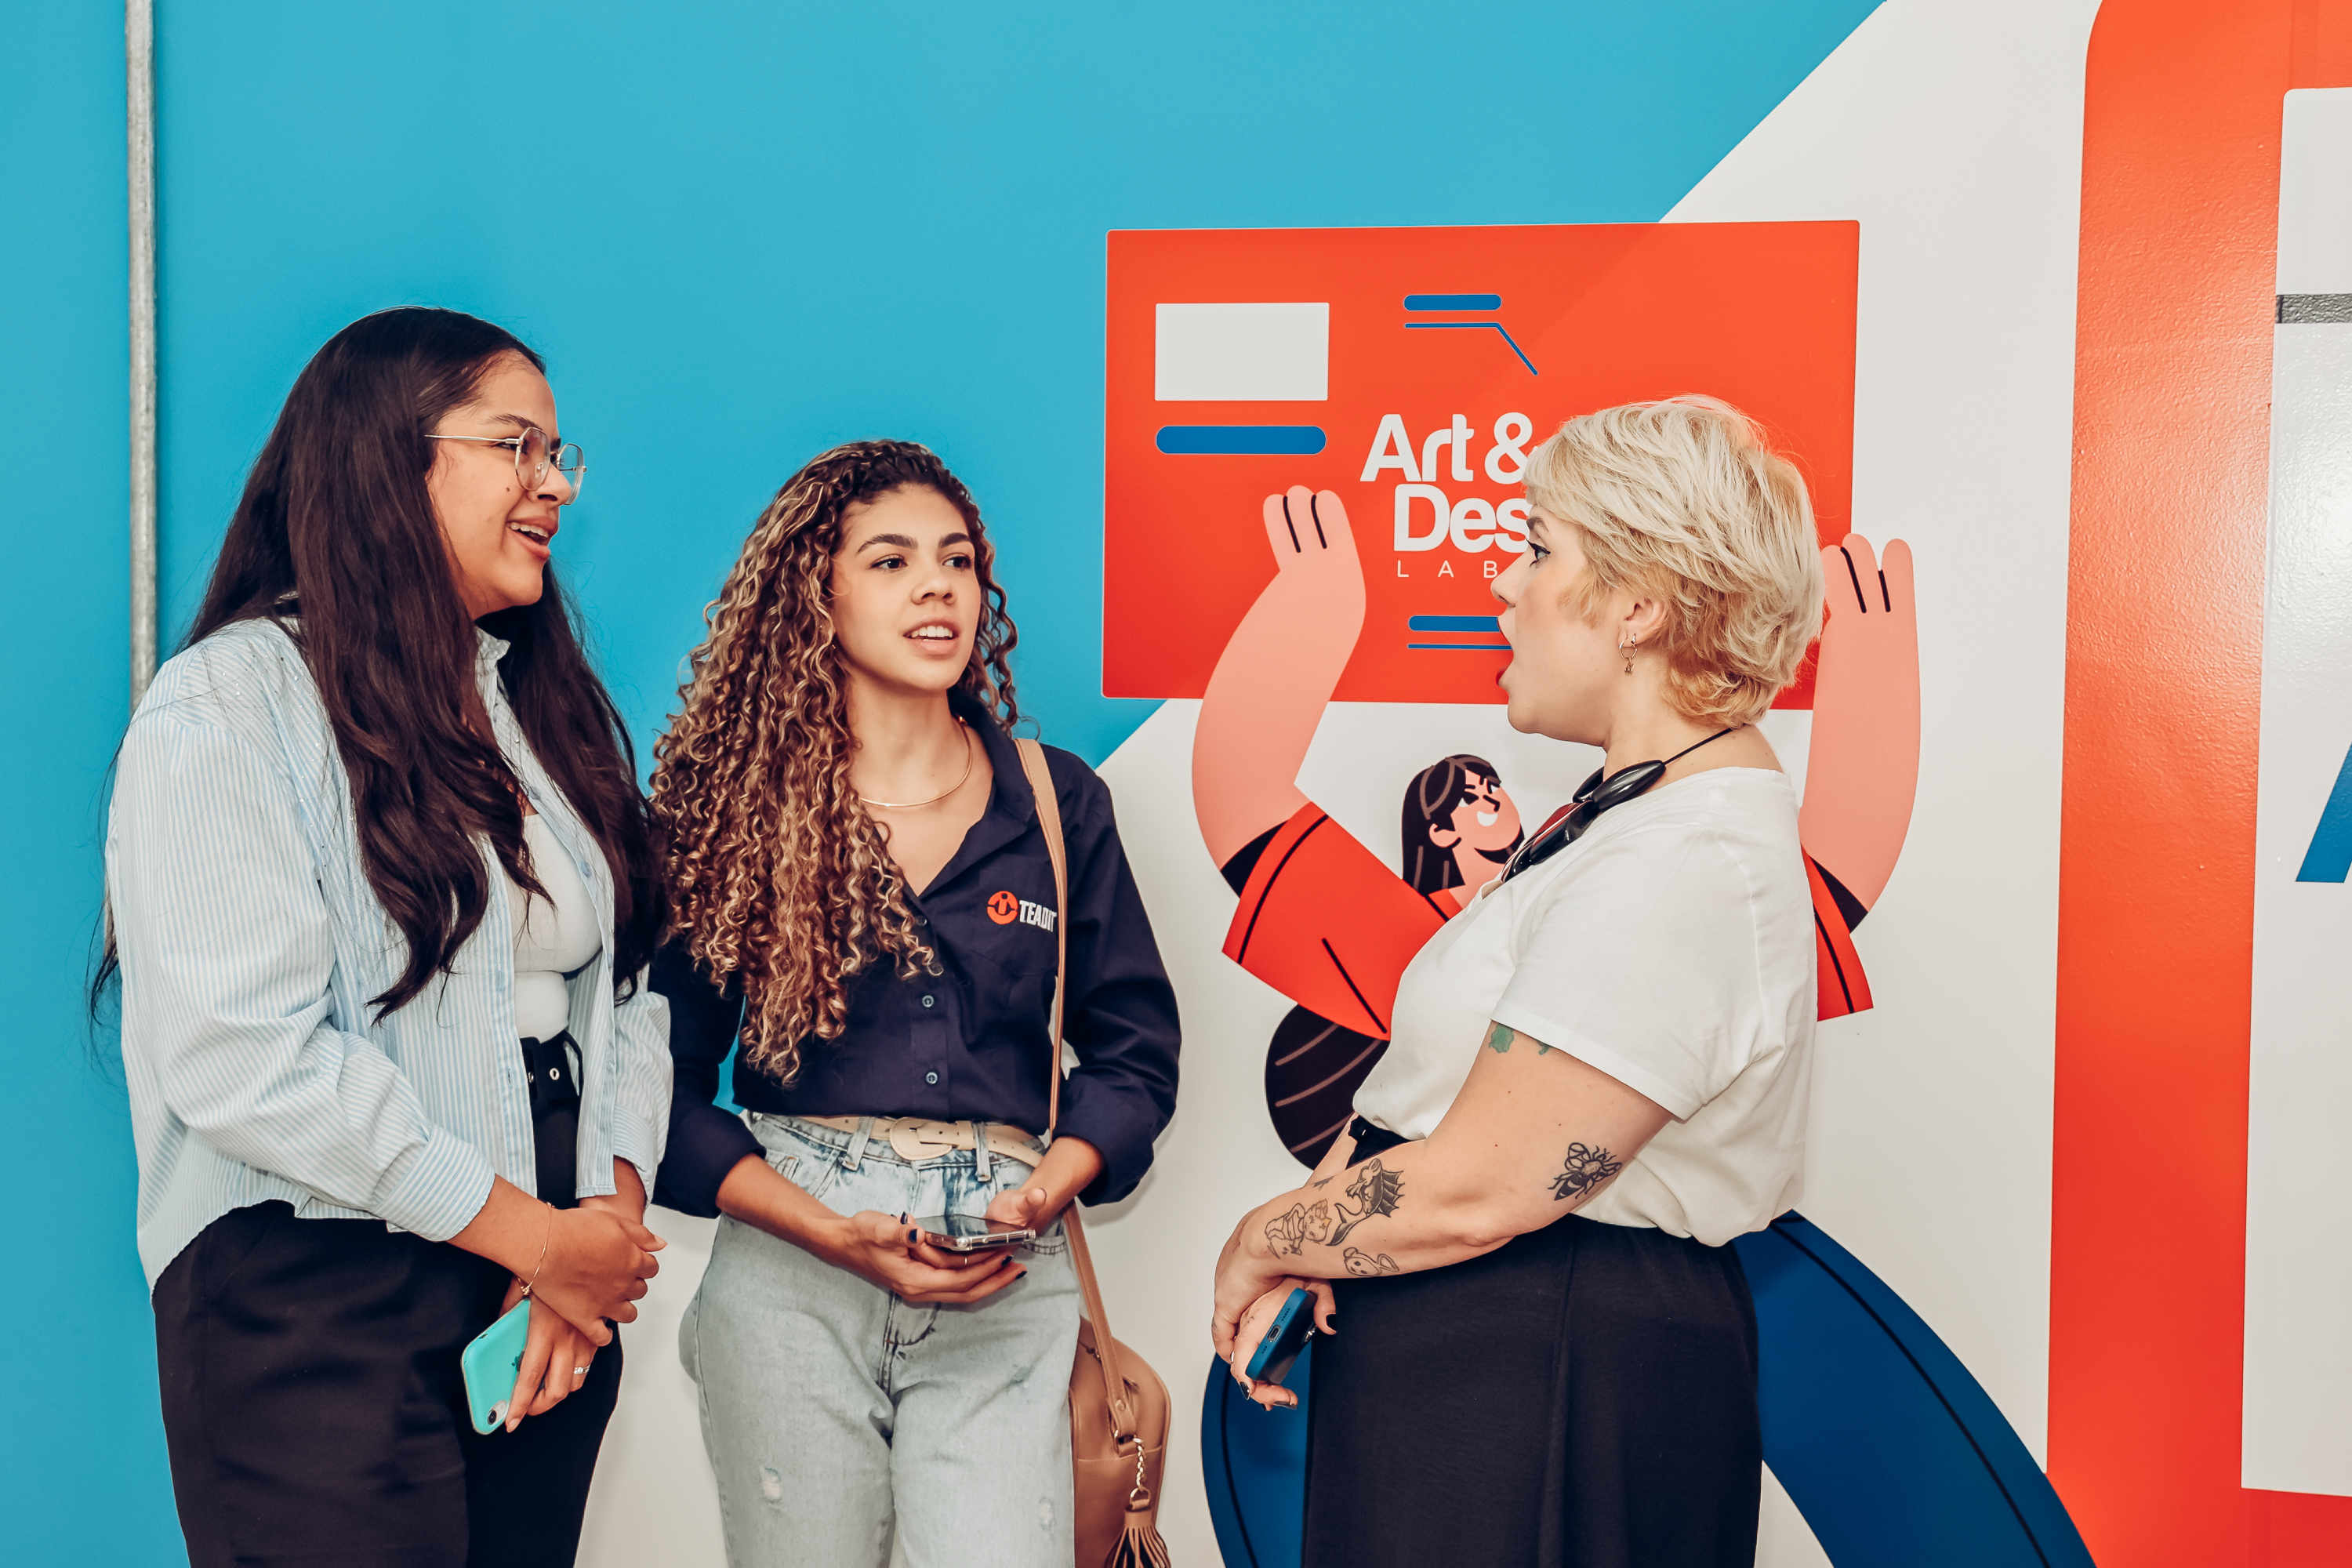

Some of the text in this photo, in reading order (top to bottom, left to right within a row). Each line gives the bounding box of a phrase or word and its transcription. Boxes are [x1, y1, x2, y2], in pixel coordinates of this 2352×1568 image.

[1359, 412, 1535, 485] Art &
[1394, 483, 1533, 554] Des
